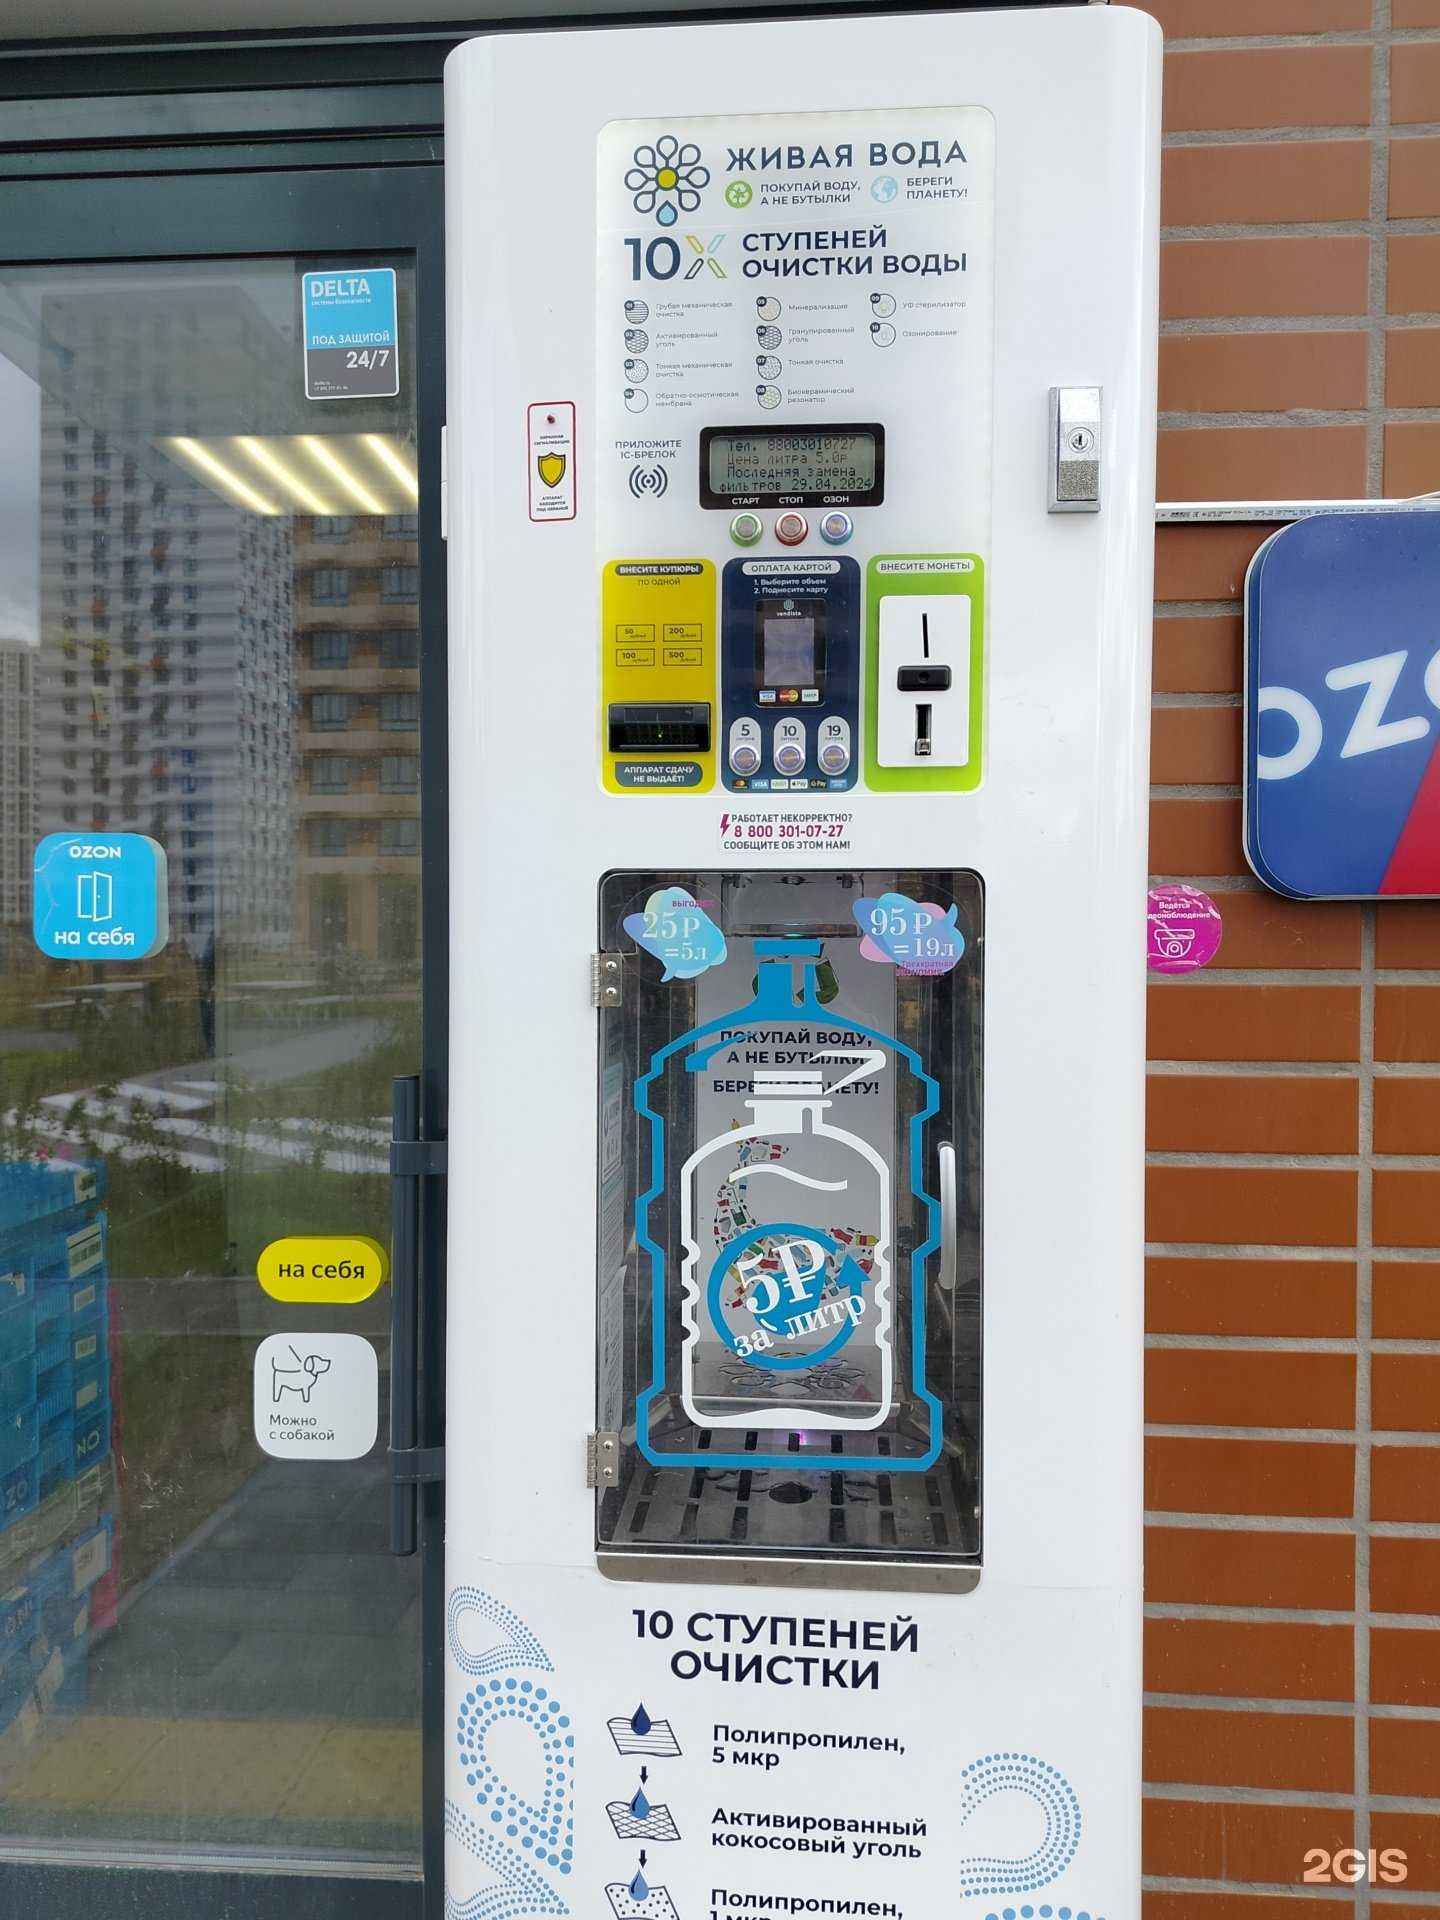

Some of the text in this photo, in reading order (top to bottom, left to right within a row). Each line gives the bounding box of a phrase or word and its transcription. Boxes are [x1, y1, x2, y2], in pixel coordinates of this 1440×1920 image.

[725, 140, 968, 172] ЖИВАЯ ВОДА
[760, 180, 861, 193] ПОКУПАЙ ВОДУ,
[906, 176, 953, 187] БЕРЕГИ
[760, 193, 851, 206] А НЕ БУТЫЛКИ
[906, 188, 968, 200] ПЛАНЕТУ!
[742, 224, 888, 252] СТУПЕНЕЙ
[742, 253, 967, 278] ОЧИСТКИ ВОДЫ
[311, 278, 370, 298] DELTA
[312, 330, 390, 345] ПОД ЗАЩИТОЙ
[346, 350, 391, 371] 24/7
[615, 439, 683, 450] ПРИЛОЖИТЕ
[728, 438, 856, 452] Тел. 88003010727
[728, 453, 760, 466] Цена
[767, 452, 808, 464] литра
[728, 466, 856, 479] Последняя замена
[791, 477, 873, 491] 29.04.2024
[732, 497, 760, 505] СТАРТ
[778, 496, 804, 504] СТОП
[619, 564, 699, 574] ВНЕСИТЕ КУПЮРЫ
[751, 562, 832, 573] ОПЛАТА КАРТОЙ
[880, 562, 970, 571] ВНЕСИТЕ МОНЕТЫ
[638, 576, 681, 586] ПО ОДНОЙ
[760, 578, 799, 587] Выберите
[762, 586, 805, 595] Поднесите
[1257, 648, 1440, 780] OZ
[742, 724, 750, 736] 5
[783, 725, 797, 736] 10
[827, 725, 841, 736] 19
[624, 766, 695, 775] АППАРАТ СДАЧУ
[731, 812, 853, 824] РАБОТАЕТ НЕКОРРЕКТНО?
[734, 825, 844, 838] 8 800 301-07-27
[70, 845, 123, 858] OZON
[723, 840, 851, 852] СООБЩИТЕ ОБ ЭТОМ НАМ!
[1147, 912, 1211, 920] деонаблюдение
[54, 926, 136, 945] на себя
[720, 1028, 872, 1048] ПОКУПАЙ ВОДУ,
[727, 1051, 740, 1064] А
[746, 1051, 770, 1064] НЕ
[279, 1260, 366, 1280] на себя
[733, 1295, 866, 1357] за литр
[270, 1414, 318, 1426] Можно
[269, 1428, 336, 1441] с собакой
[632, 1608, 918, 1652] 10 СТУПЕНЕЙ
[670, 1649, 879, 1690] ОЧИСТКИ
[713, 1724, 905, 1755] Полипропилен,
[712, 1747, 780, 1771] 5 мкр
[712, 1807, 927, 1836] Активированный
[712, 1832, 922, 1859] кокосовый уголь
[712, 1888, 903, 1920] Полипропилен,
